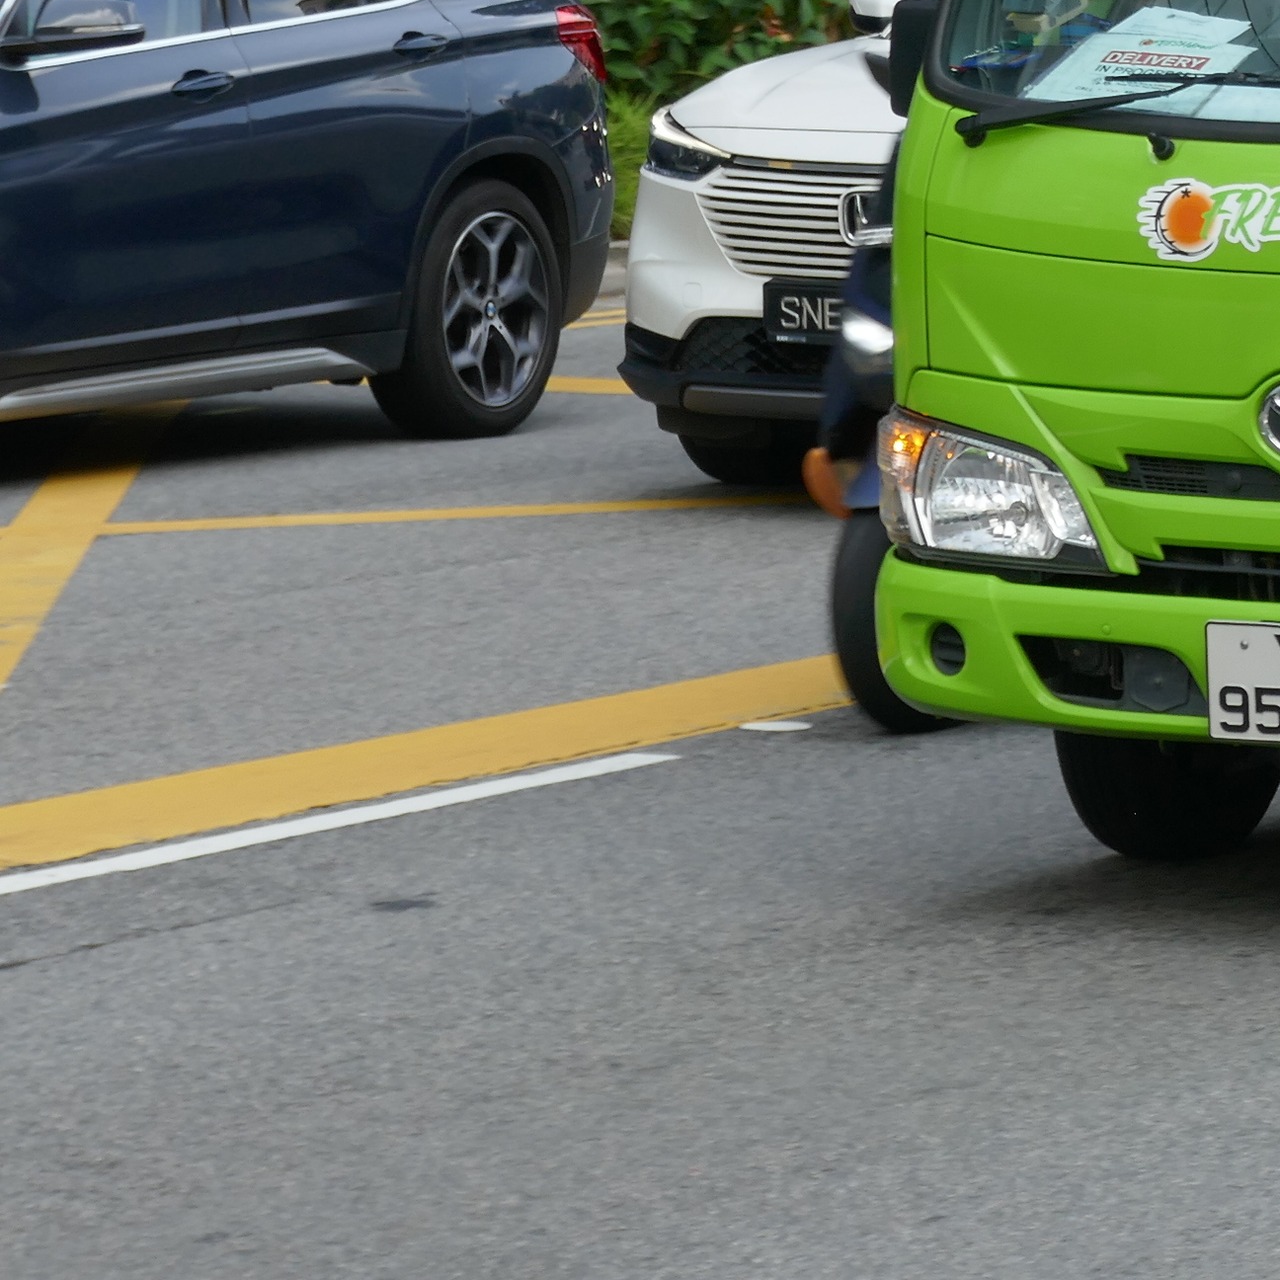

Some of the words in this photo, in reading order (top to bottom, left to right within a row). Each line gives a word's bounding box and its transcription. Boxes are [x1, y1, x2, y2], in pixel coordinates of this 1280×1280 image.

[1094, 64, 1111, 73] IN
[1104, 51, 1206, 69] DELIVERY
[780, 295, 844, 331] SNE
